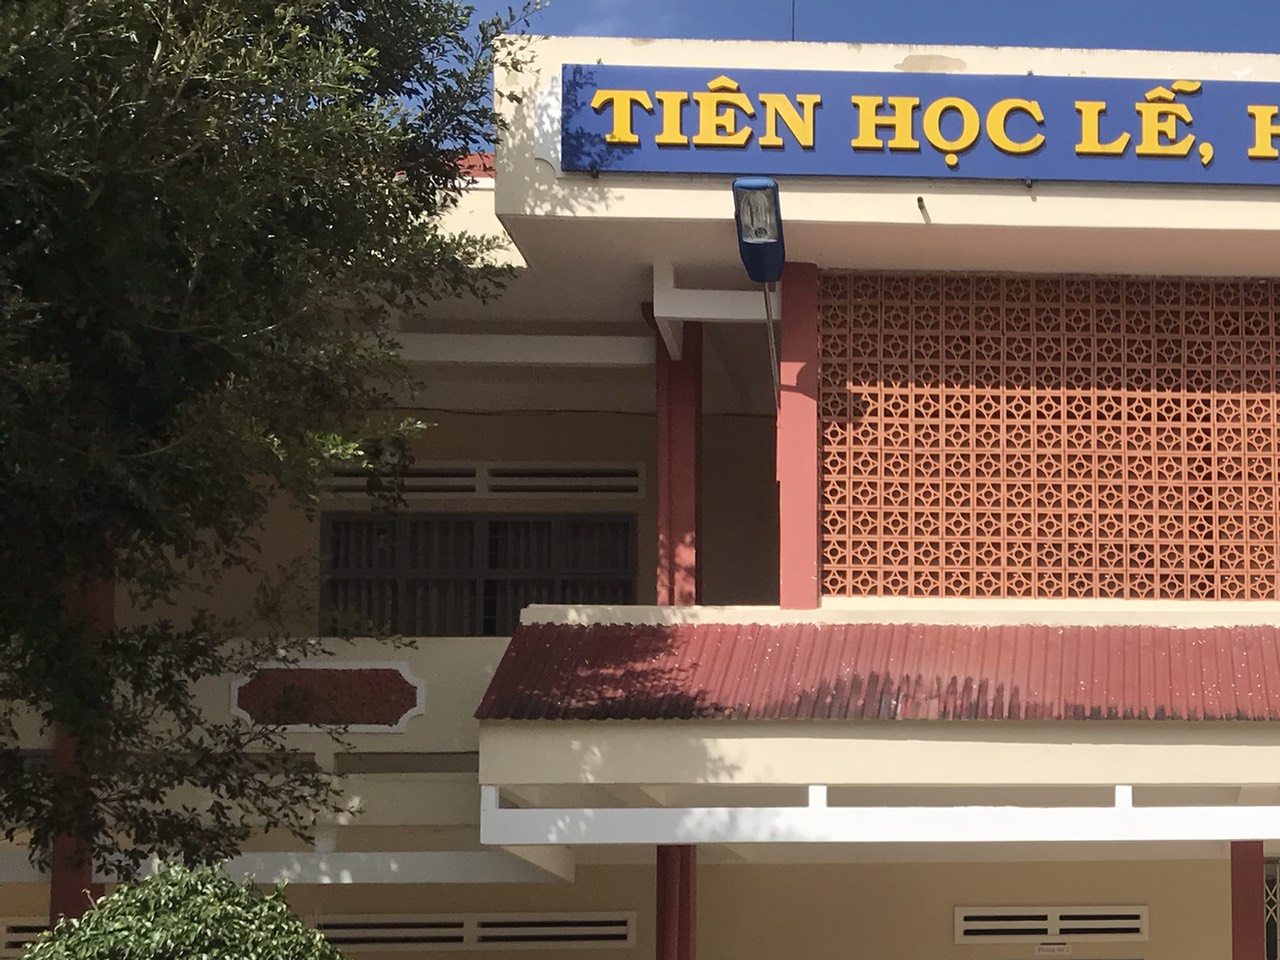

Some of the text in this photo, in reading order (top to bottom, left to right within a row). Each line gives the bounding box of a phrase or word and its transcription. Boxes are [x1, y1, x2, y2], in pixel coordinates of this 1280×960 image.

[591, 76, 820, 148] TIÊN
[851, 95, 1045, 166] HỌC
[1075, 80, 1214, 165] LỄ,
